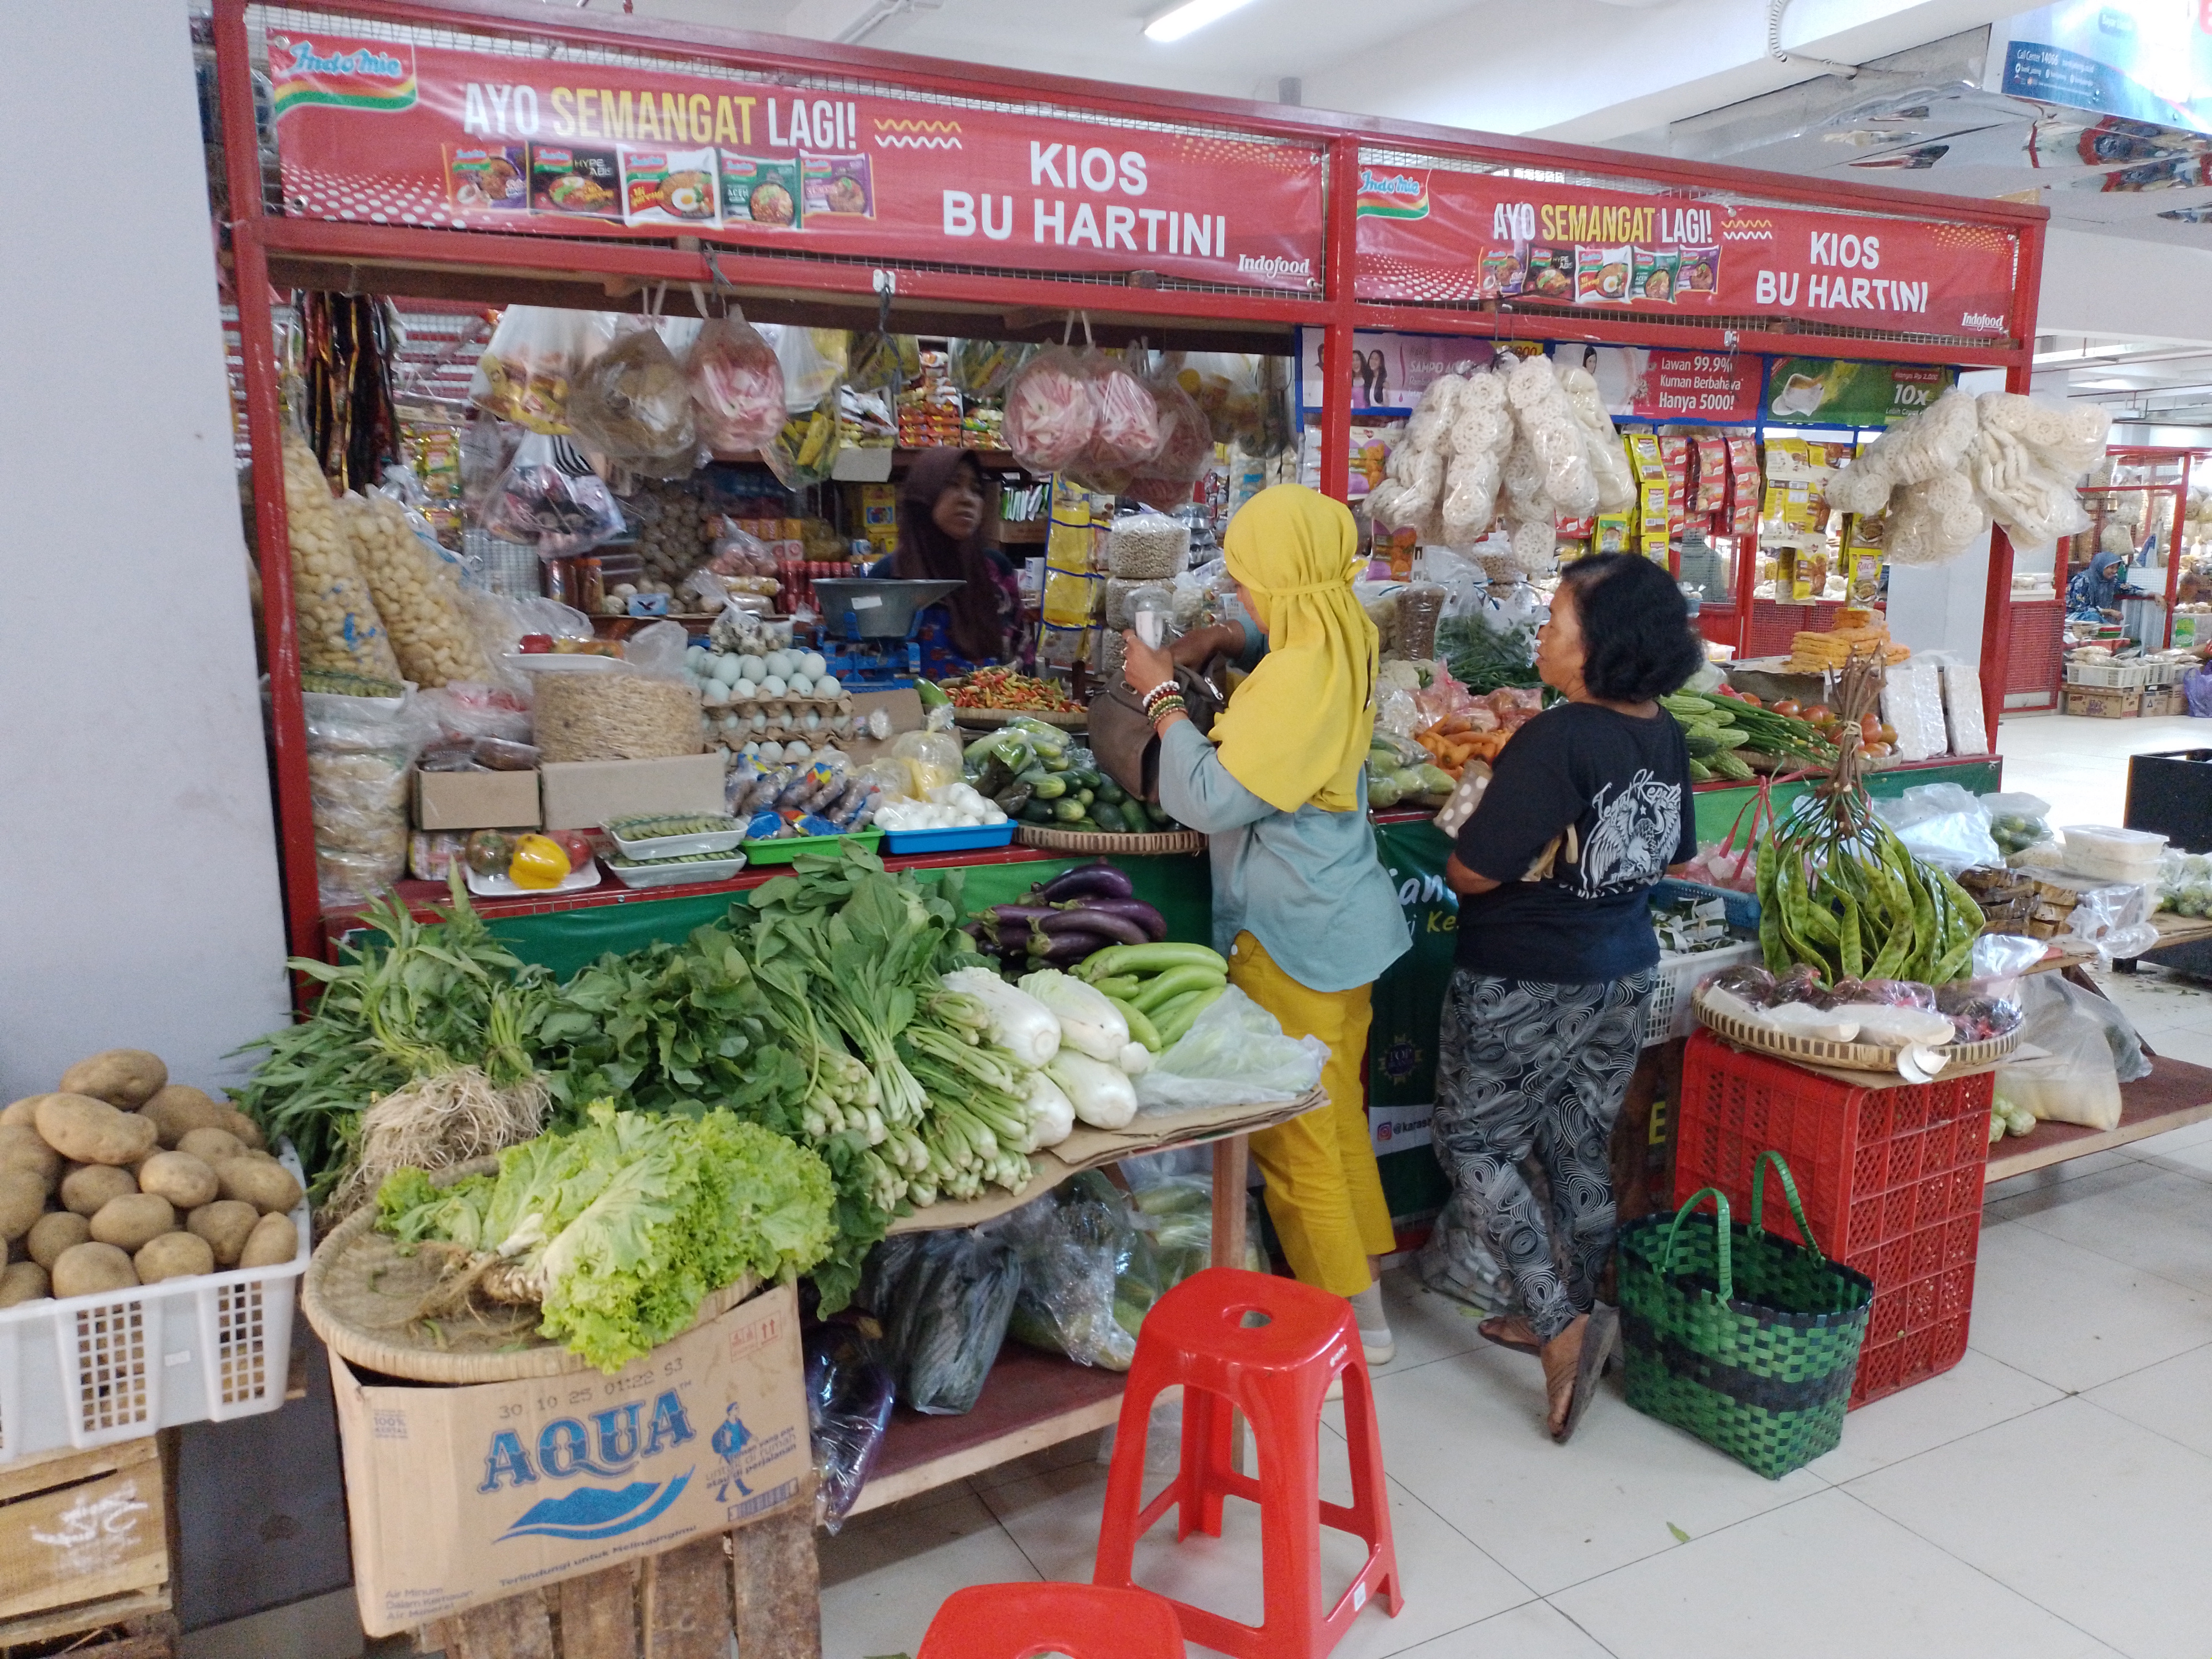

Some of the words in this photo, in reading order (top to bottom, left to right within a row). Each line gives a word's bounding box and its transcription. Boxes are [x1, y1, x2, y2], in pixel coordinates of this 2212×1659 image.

[462, 81, 540, 137] AYO
[550, 86, 758, 145] SEMANGAT
[766, 96, 857, 151] LAGI!
[573, 158, 604, 168] HYPE
[1029, 140, 1148, 195] KIOS
[942, 190, 1013, 240] BU
[1034, 197, 1227, 258] HARTINI
[1493, 202, 1536, 241] AYO
[1541, 204, 1656, 243] SEMANGAT
[1661, 207, 1713, 244] LAGI!
[1809, 231, 1880, 270] KIOS
[1238, 253, 1310, 279] Indofood
[1756, 270, 1799, 306] BU
[1808, 275, 1929, 314] HARTINI
[1961, 312, 2004, 332] Indofood
[1410, 361, 1443, 374] SAMPO
[1661, 357, 1691, 371] Lawan
[1693, 356, 1733, 373] 99.9%
[1660, 374, 1692, 389] Kuman
[1893, 383, 1929, 406] 10x
[1658, 392, 1697, 413] Hanya
[1699, 394, 1735, 410] 5000!
[499, 1404, 523, 1419] 30
[537, 1396, 558, 1411] 10
[568, 1387, 593, 1405] 25
[604, 1370, 656, 1396] 01:22
[374, 1416, 406, 1427] 100%
[477, 1386, 696, 1494] AQUA
[760, 1433, 797, 1459] rumah
[745, 1444, 797, 1476] perjalanan
[499, 1561, 571, 1587] Terlindungi
[573, 1550, 609, 1566] untuk
[385, 1589, 401, 1599] Air
[404, 1586, 444, 1598] Minum
[385, 1598, 420, 1610] Dalam
[387, 1610, 404, 1621] Air
